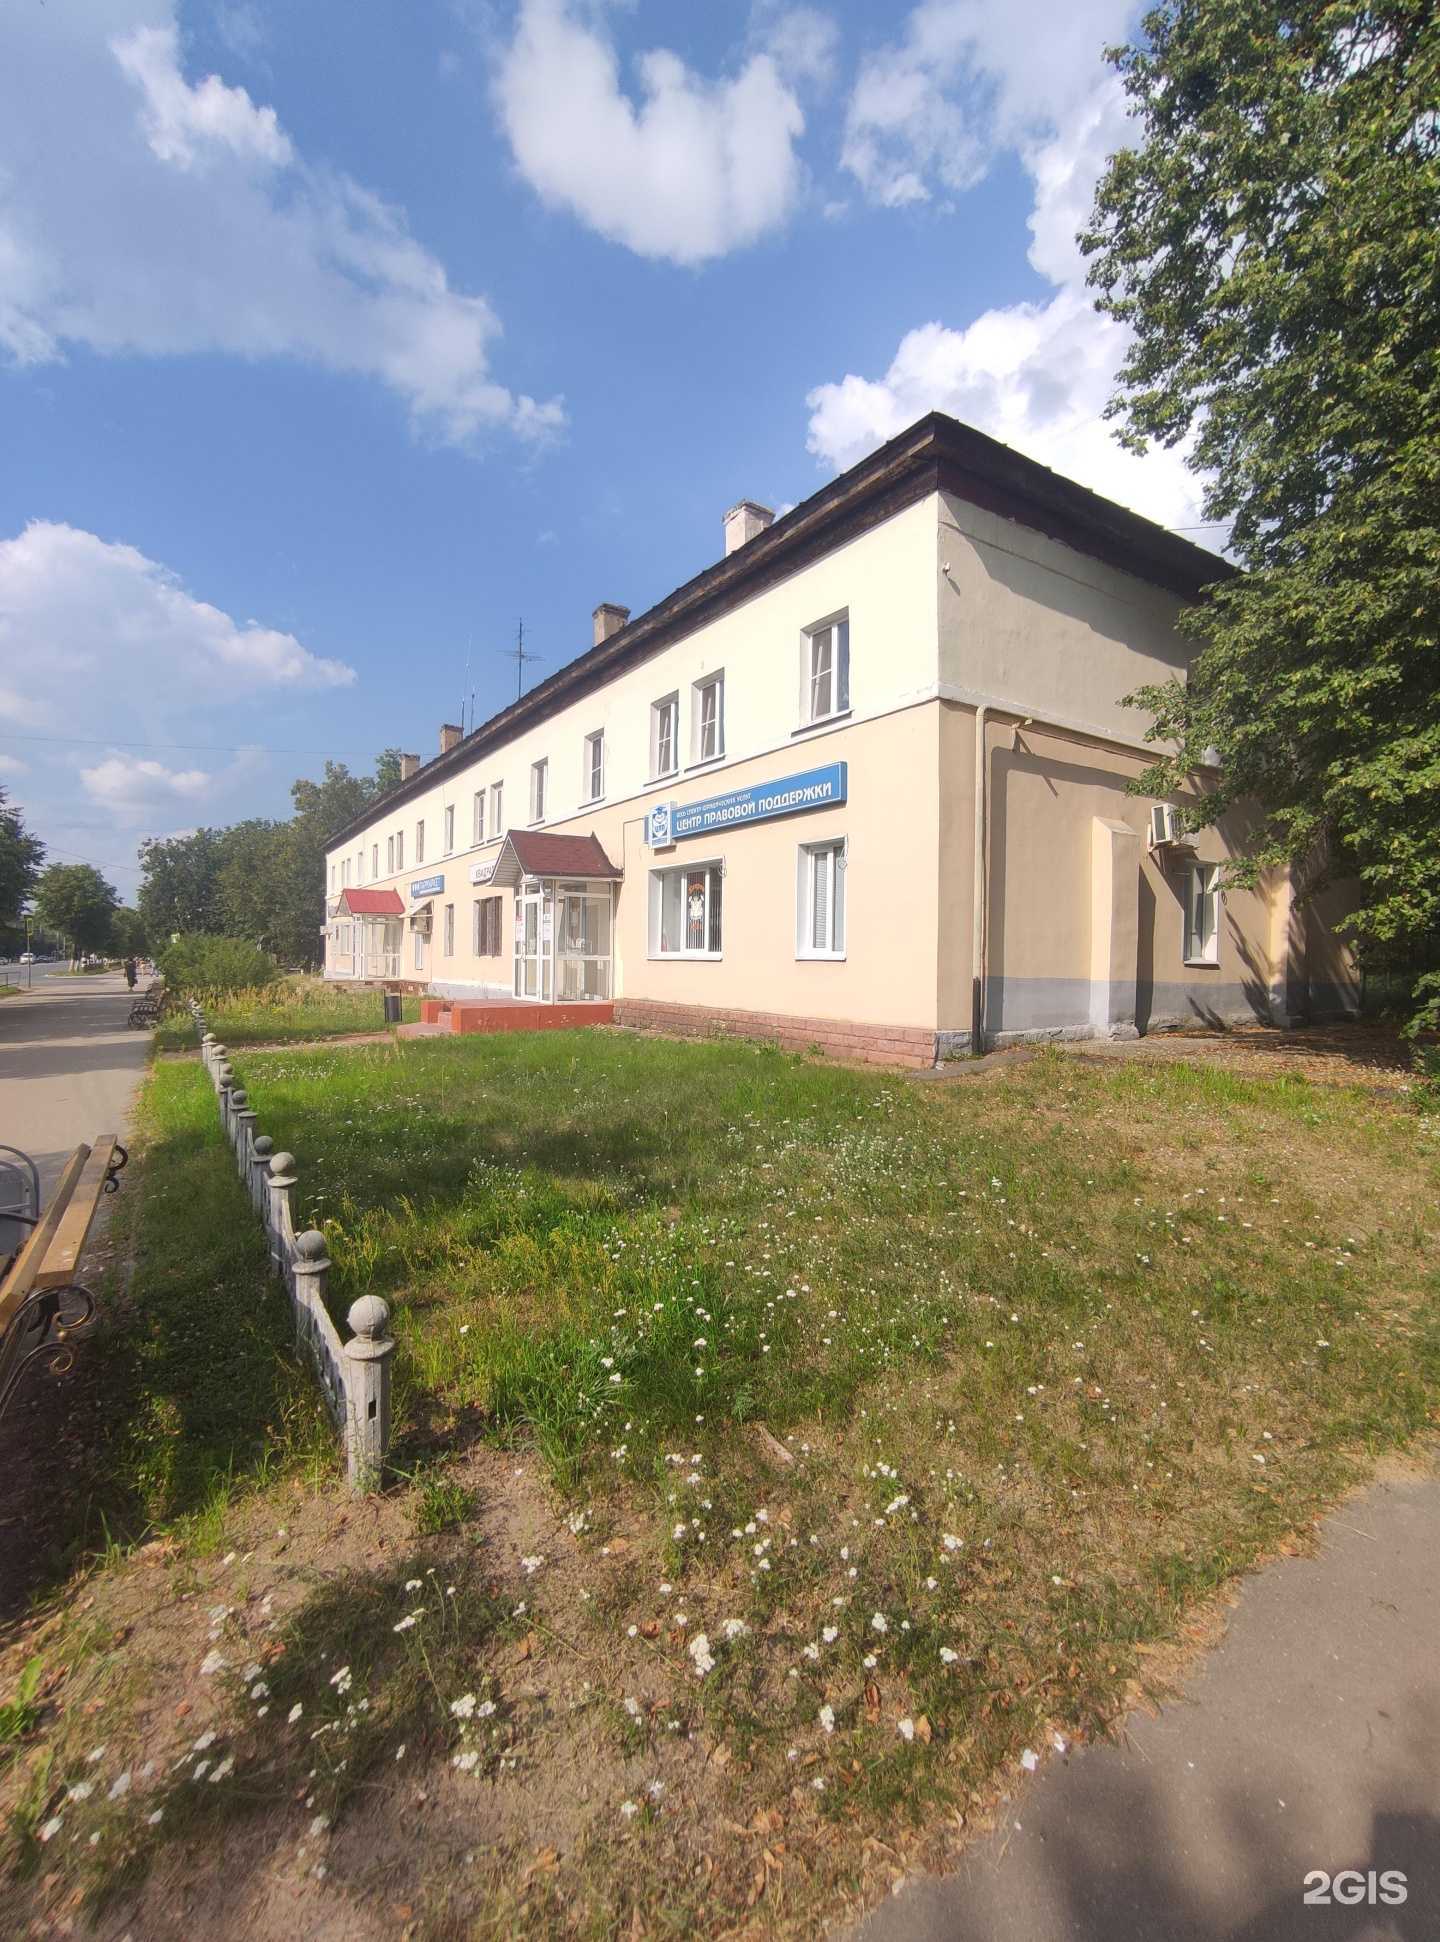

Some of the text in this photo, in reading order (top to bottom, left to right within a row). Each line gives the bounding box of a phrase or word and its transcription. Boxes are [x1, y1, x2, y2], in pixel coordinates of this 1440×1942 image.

[676, 782, 832, 831] ЦЕНТР ПРАВОВОЙ ПОДДЕРЖКИ
